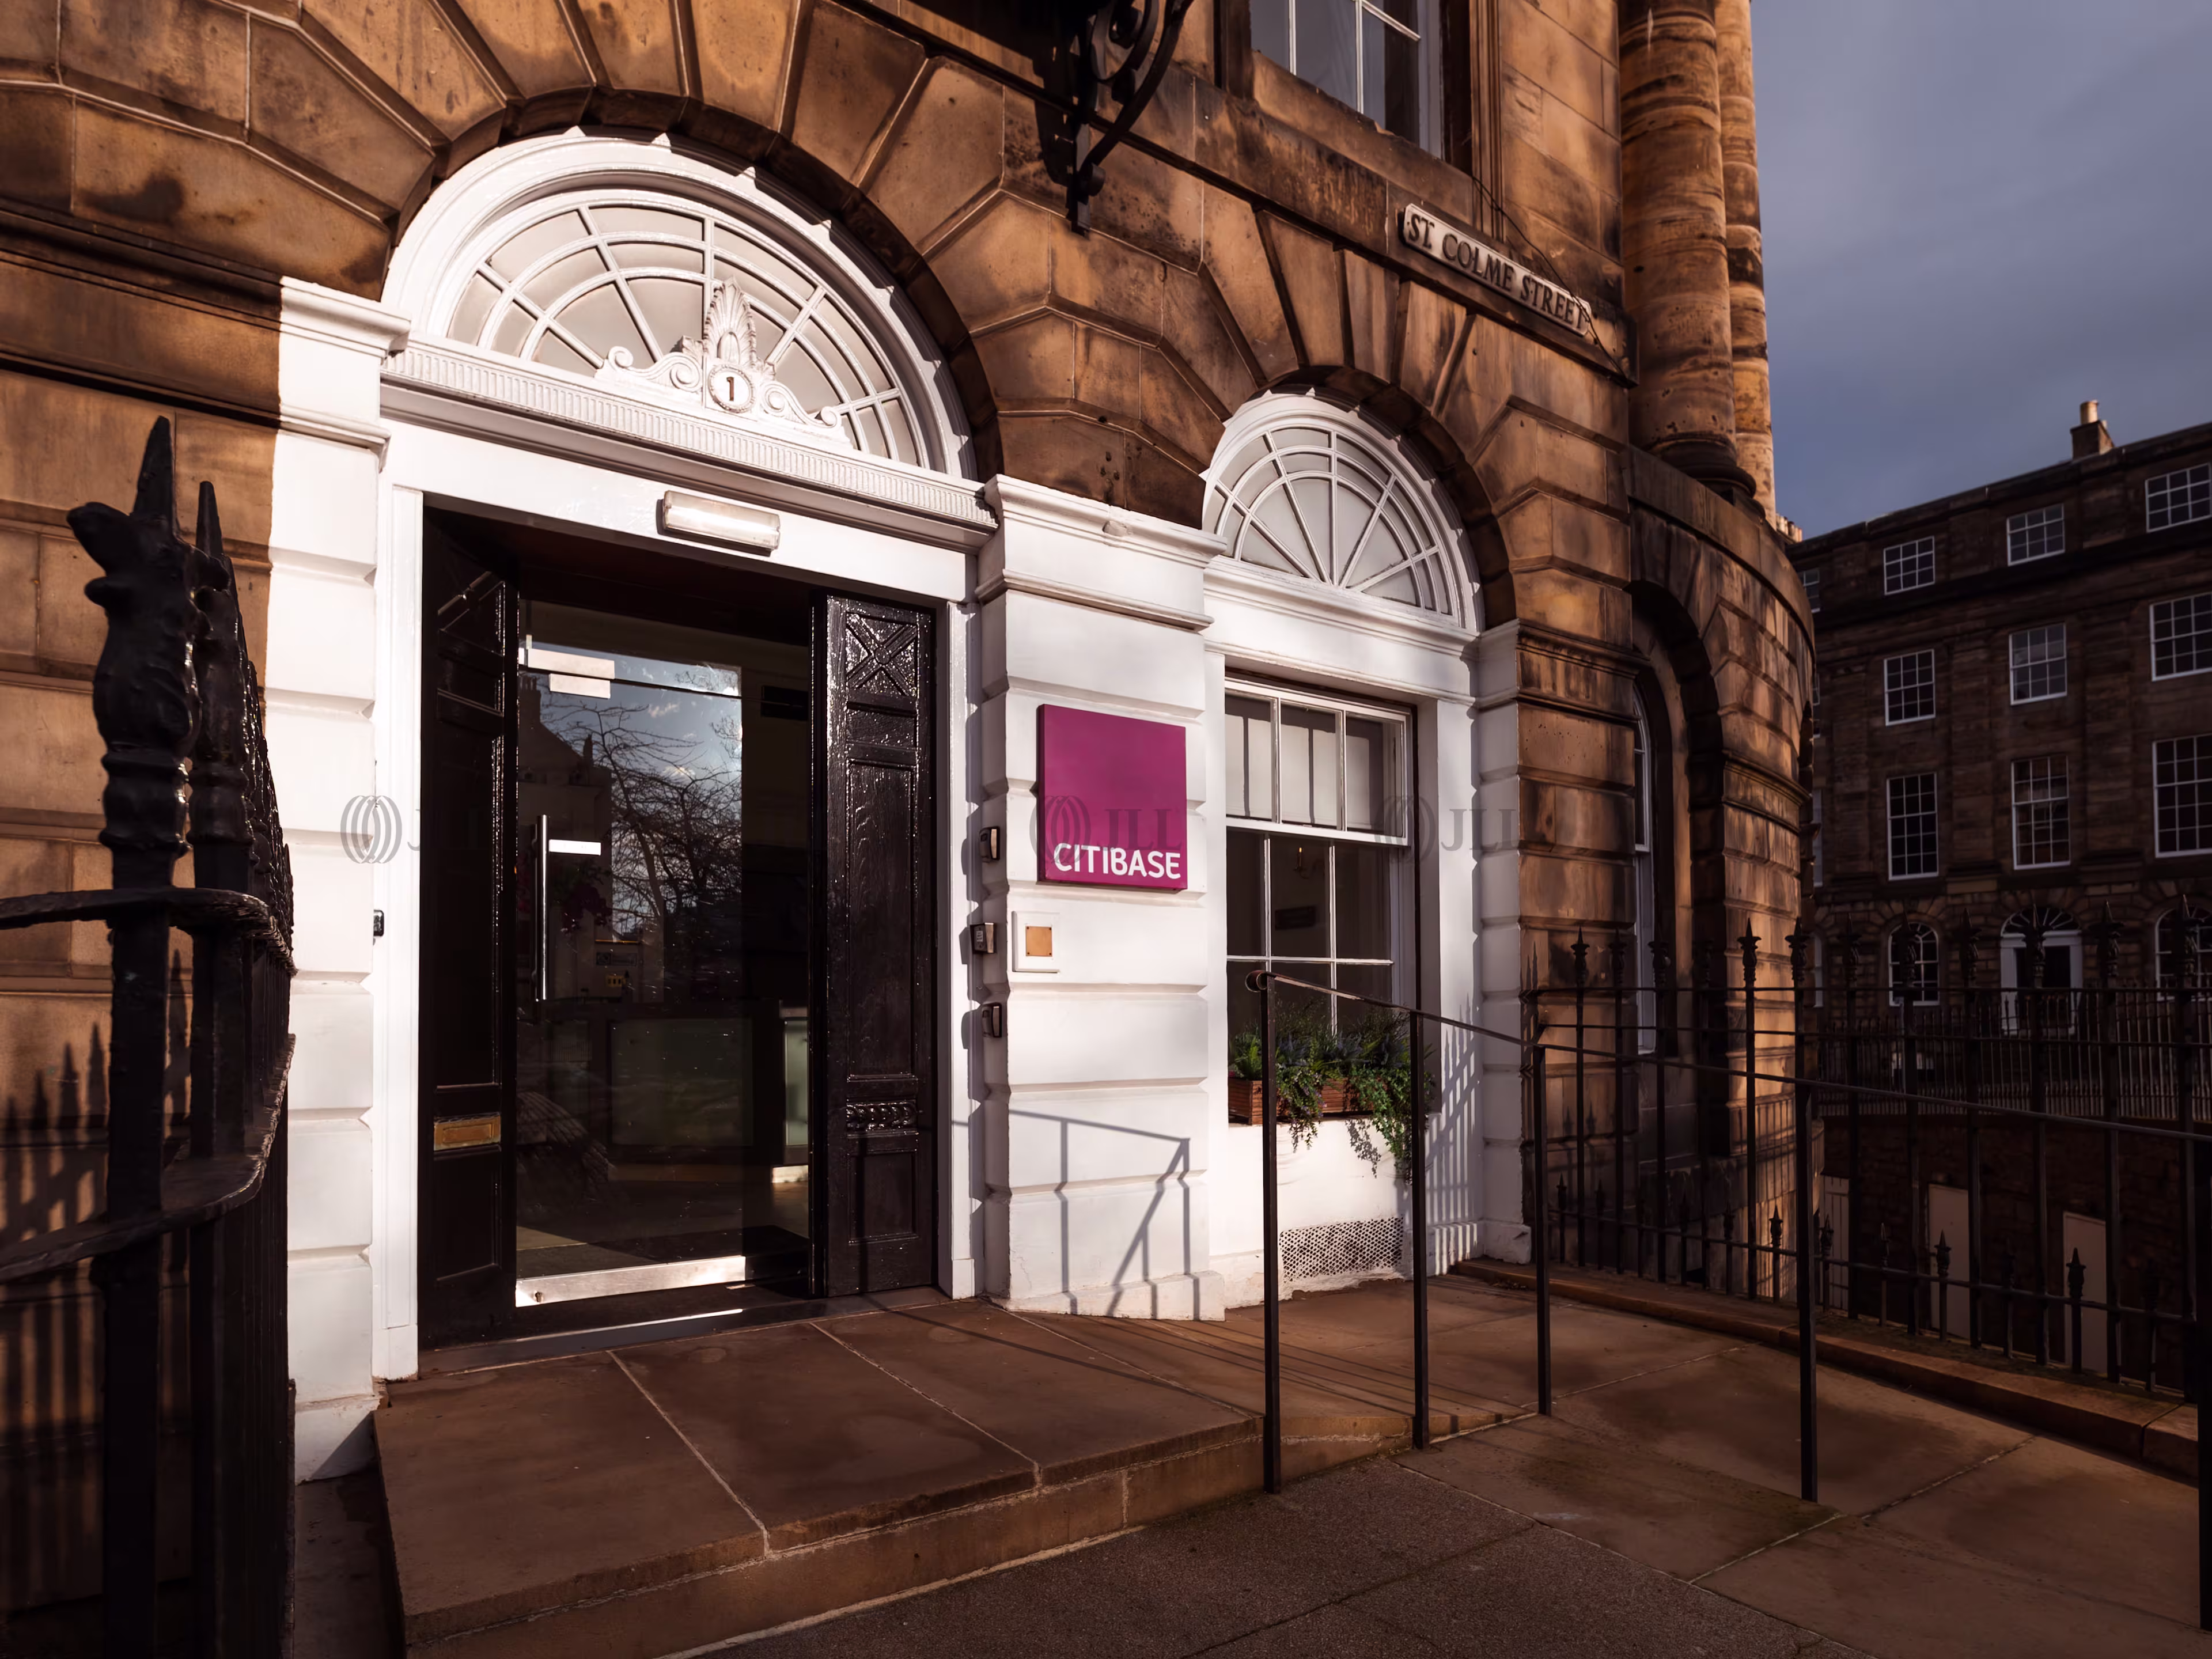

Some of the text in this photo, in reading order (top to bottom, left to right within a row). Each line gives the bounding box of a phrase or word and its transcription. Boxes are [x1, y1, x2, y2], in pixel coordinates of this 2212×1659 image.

[1443, 234, 1515, 291] COLME
[1521, 275, 1588, 329] STREET
[726, 376, 734, 402] 1
[1054, 842, 1181, 879] CITIBASE
